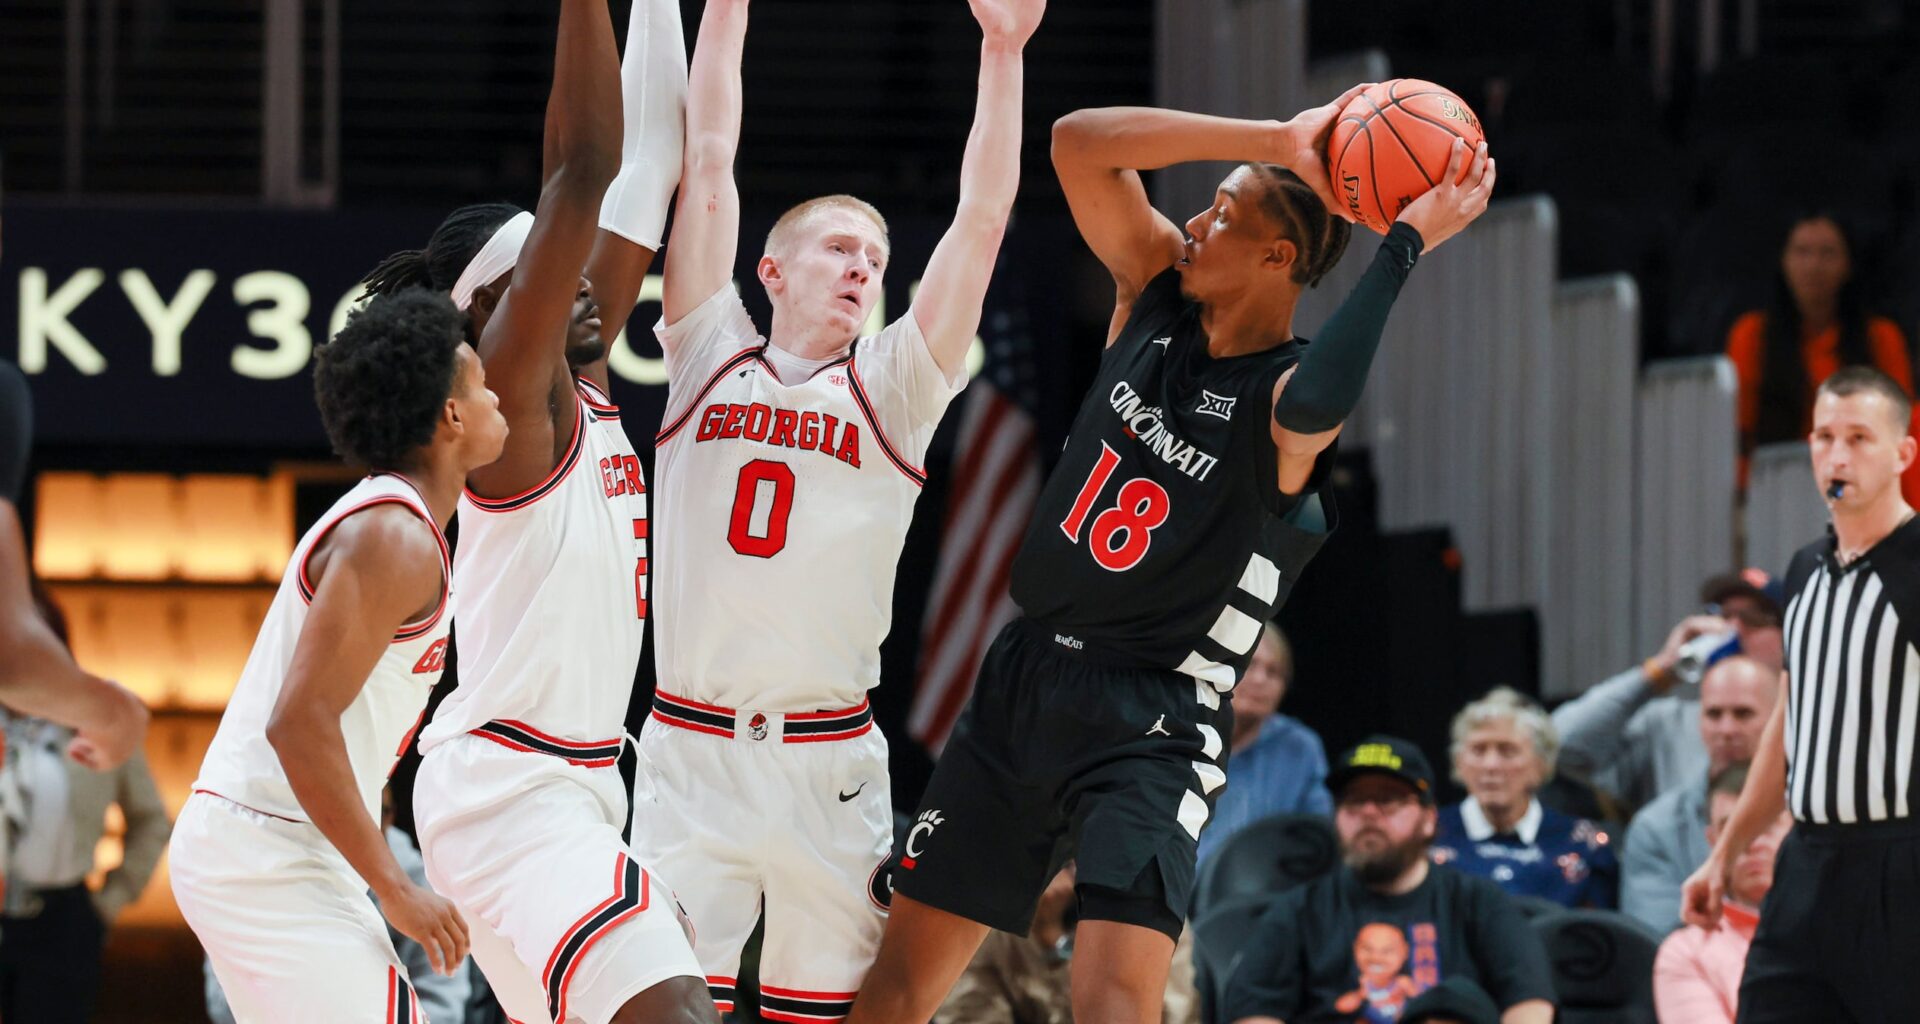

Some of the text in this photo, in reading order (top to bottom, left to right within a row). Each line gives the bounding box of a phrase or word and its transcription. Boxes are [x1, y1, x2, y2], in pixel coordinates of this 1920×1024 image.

[829, 374, 848, 386] SEC
[696, 402, 861, 469] GEORGIA
[1110, 381, 1218, 481] CINCINNATI
[727, 458, 795, 559] 0
[1060, 438, 1170, 572] 18
